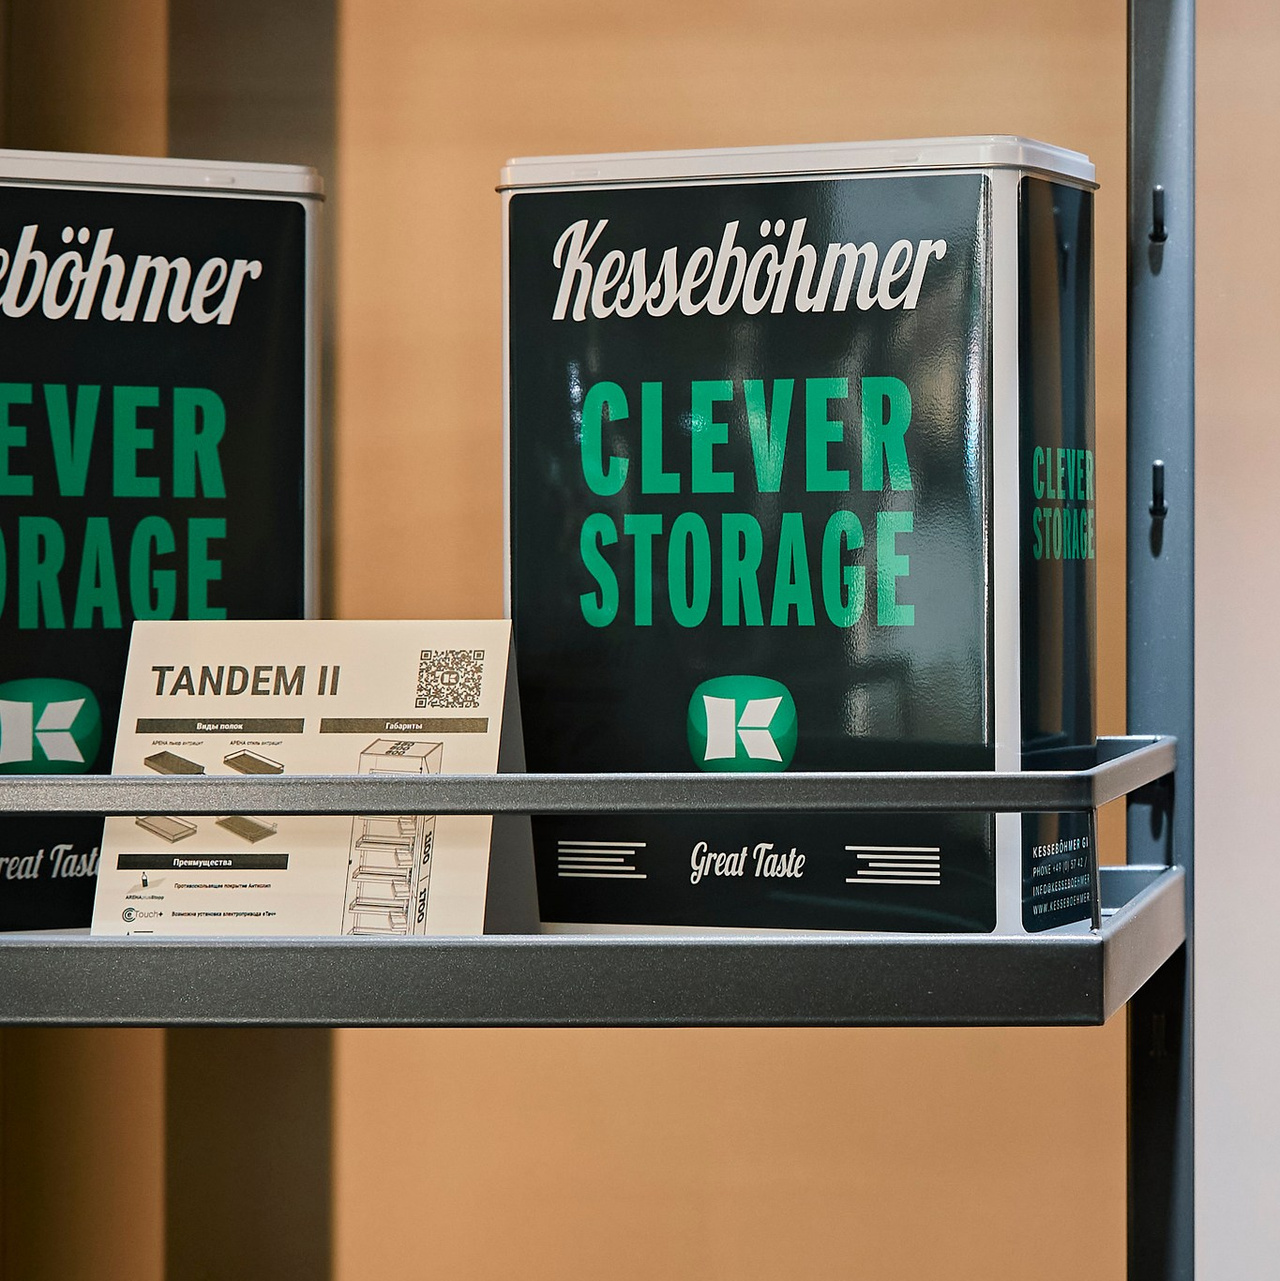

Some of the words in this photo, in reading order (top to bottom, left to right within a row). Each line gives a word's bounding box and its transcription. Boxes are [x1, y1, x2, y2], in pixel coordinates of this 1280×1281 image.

[552, 218, 947, 321] Kesseböhmer
[579, 375, 913, 497] CLEVER
[1032, 445, 1094, 500] CLEVER
[1032, 507, 1094, 560] STORAGE
[0, 516, 227, 629] RAGE
[579, 510, 915, 628] STORAGE
[152, 666, 305, 696] TANDEM
[317, 666, 340, 696] II
[196, 722, 219, 730] Виды
[385, 722, 422, 731] Габариты
[173, 858, 233, 867] Преимущества
[691, 842, 747, 885] Great
[752, 842, 806, 878] Taste
